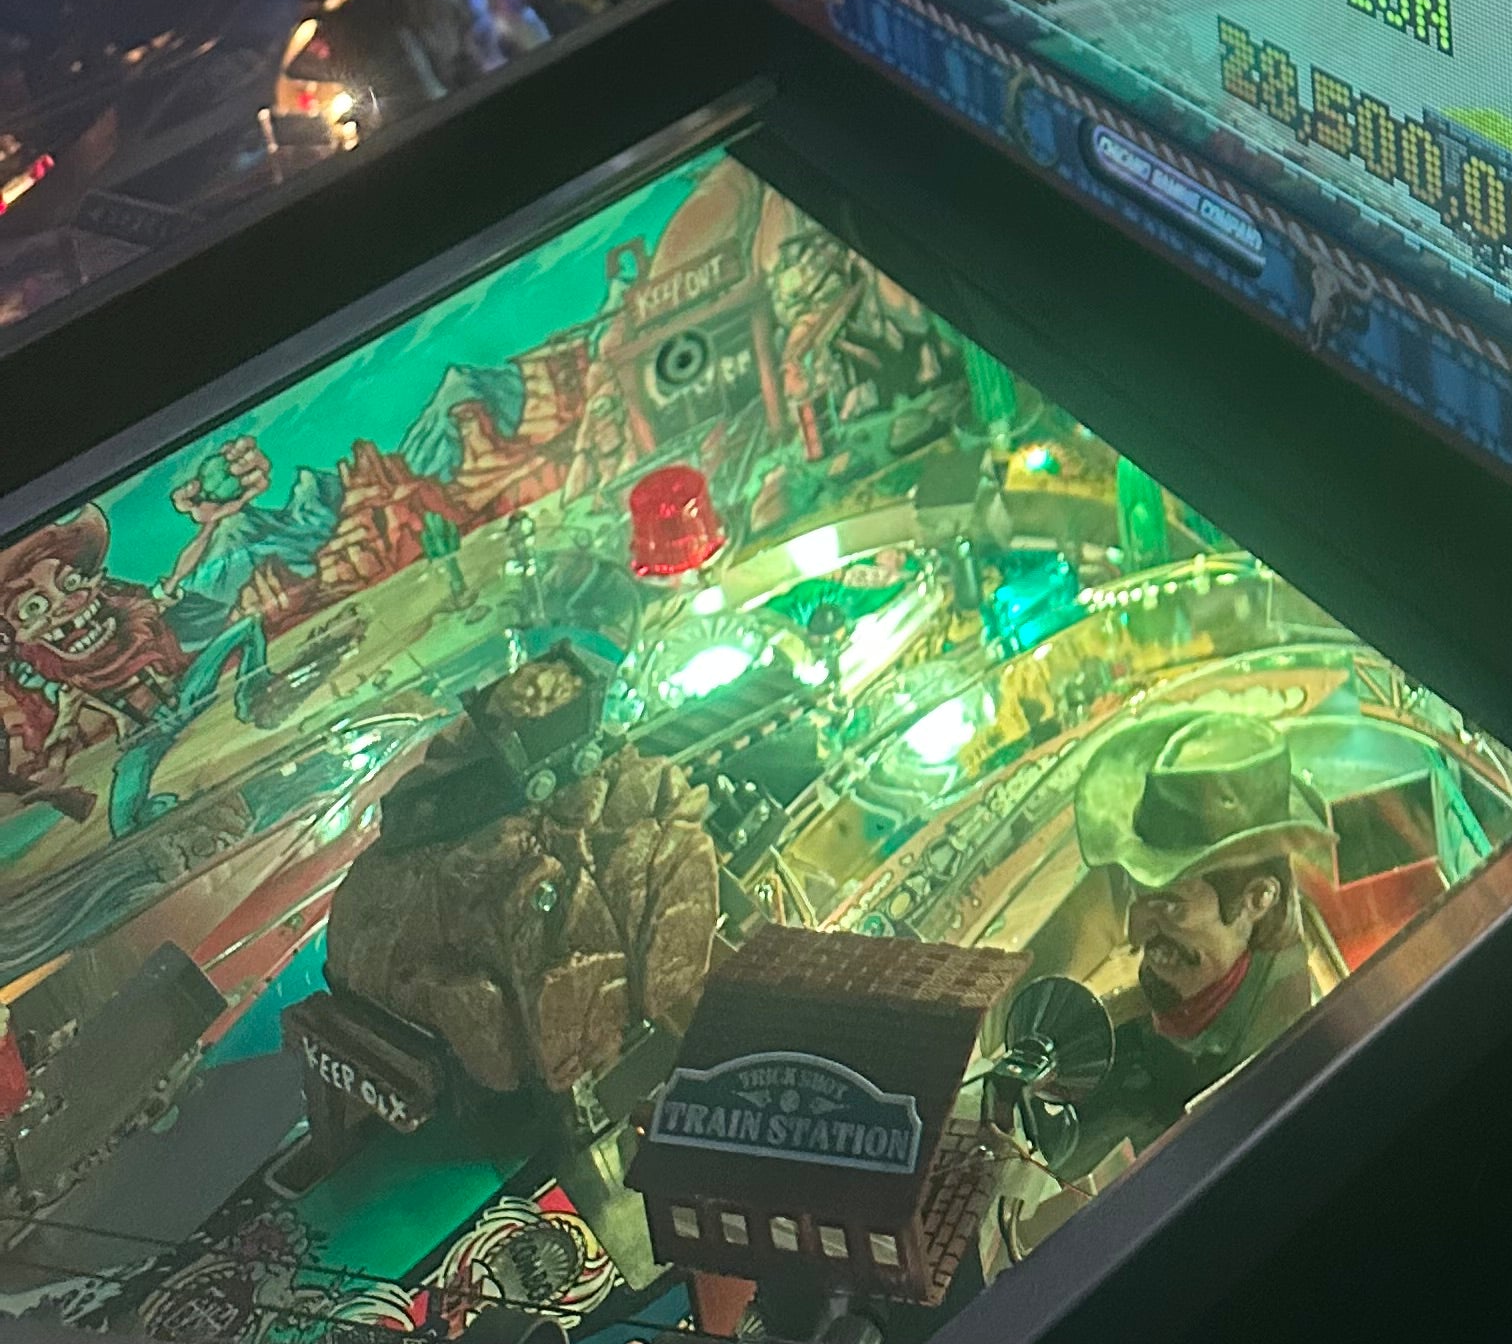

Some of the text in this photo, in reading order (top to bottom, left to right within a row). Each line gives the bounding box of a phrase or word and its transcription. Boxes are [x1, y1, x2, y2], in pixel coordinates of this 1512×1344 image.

[303, 1036, 354, 1092] KEEP
[663, 1101, 911, 1160] TRAIN STATION
